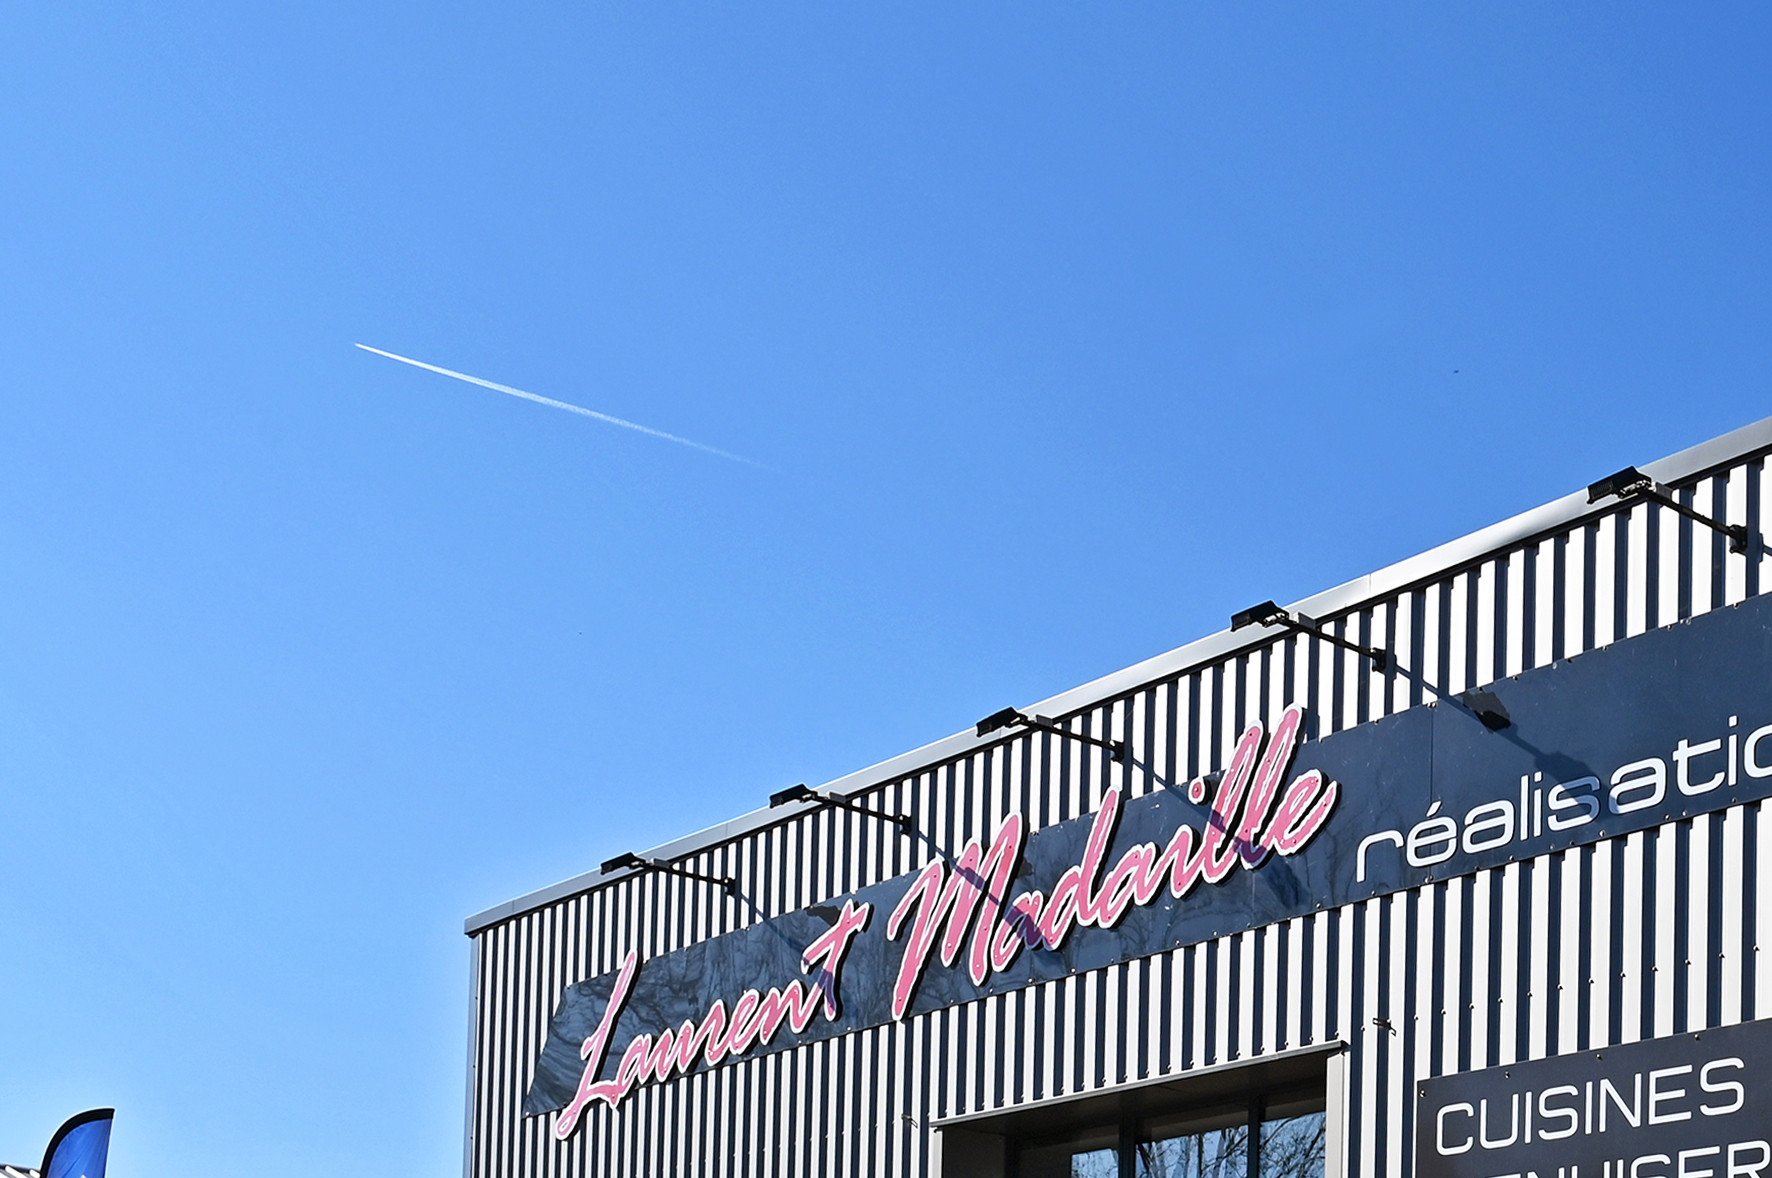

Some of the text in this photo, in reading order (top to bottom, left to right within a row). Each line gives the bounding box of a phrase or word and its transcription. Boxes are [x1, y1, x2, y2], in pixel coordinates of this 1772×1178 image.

[555, 703, 1338, 1141] Laurent Madaille
[1435, 1057, 1745, 1156] CUISINES
